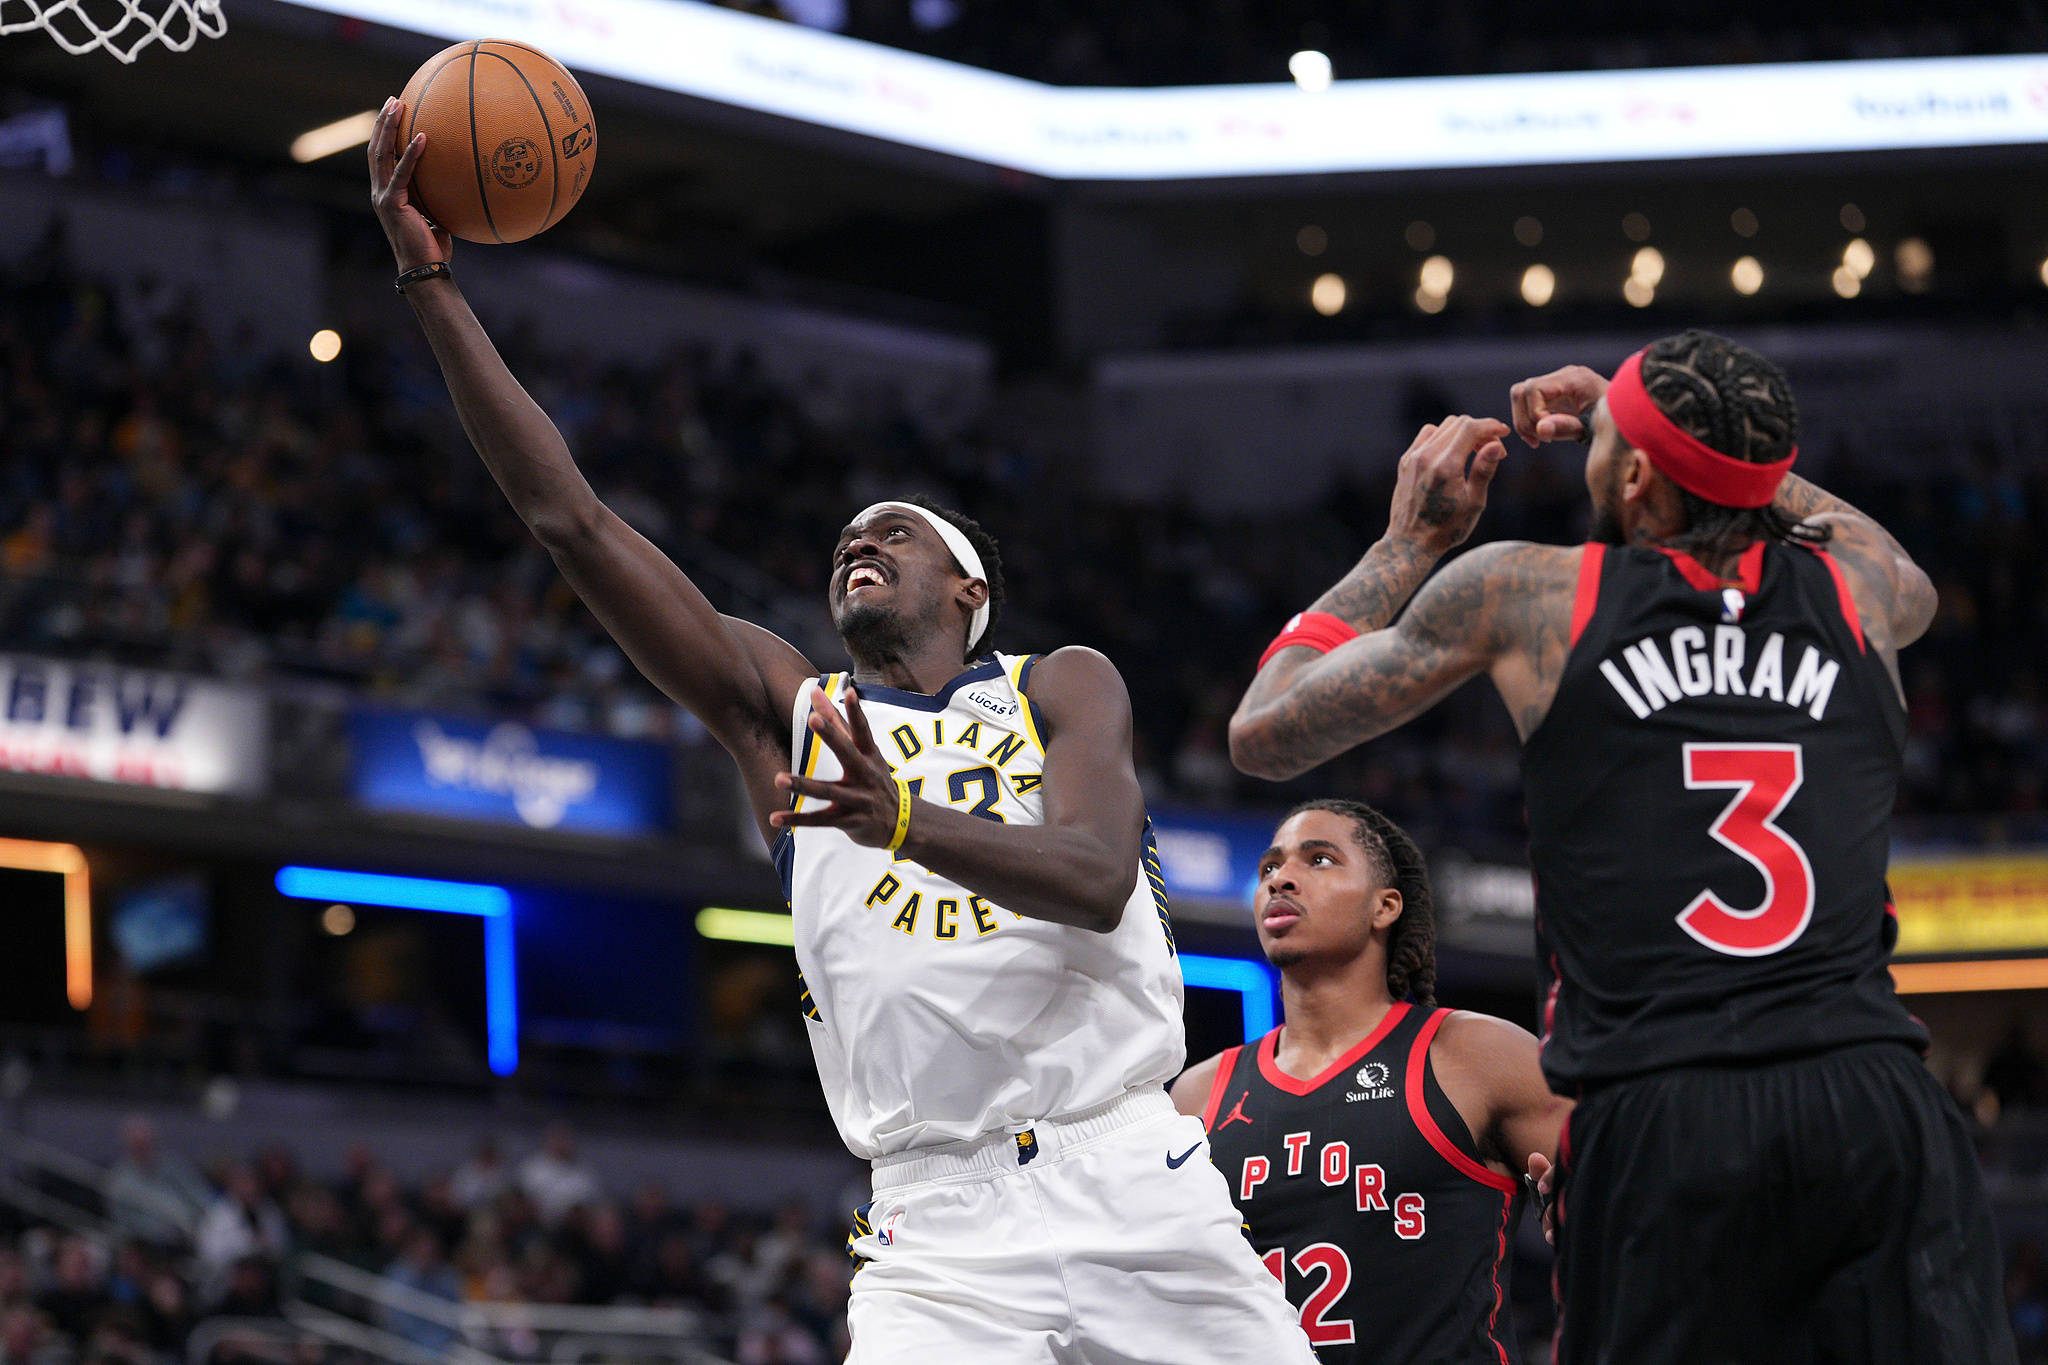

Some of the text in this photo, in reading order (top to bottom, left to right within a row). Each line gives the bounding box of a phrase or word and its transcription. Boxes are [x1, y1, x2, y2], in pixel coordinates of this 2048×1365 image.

[968, 691, 1007, 715] LUCAS
[1600, 625, 1840, 722] INGRAM
[885, 718, 1043, 798] DIANA
[1674, 742, 1816, 957] 3
[864, 870, 1023, 941] PACE
[1345, 1086, 1395, 1103] Sun Life
[1239, 1130, 1426, 1240] PTORS
